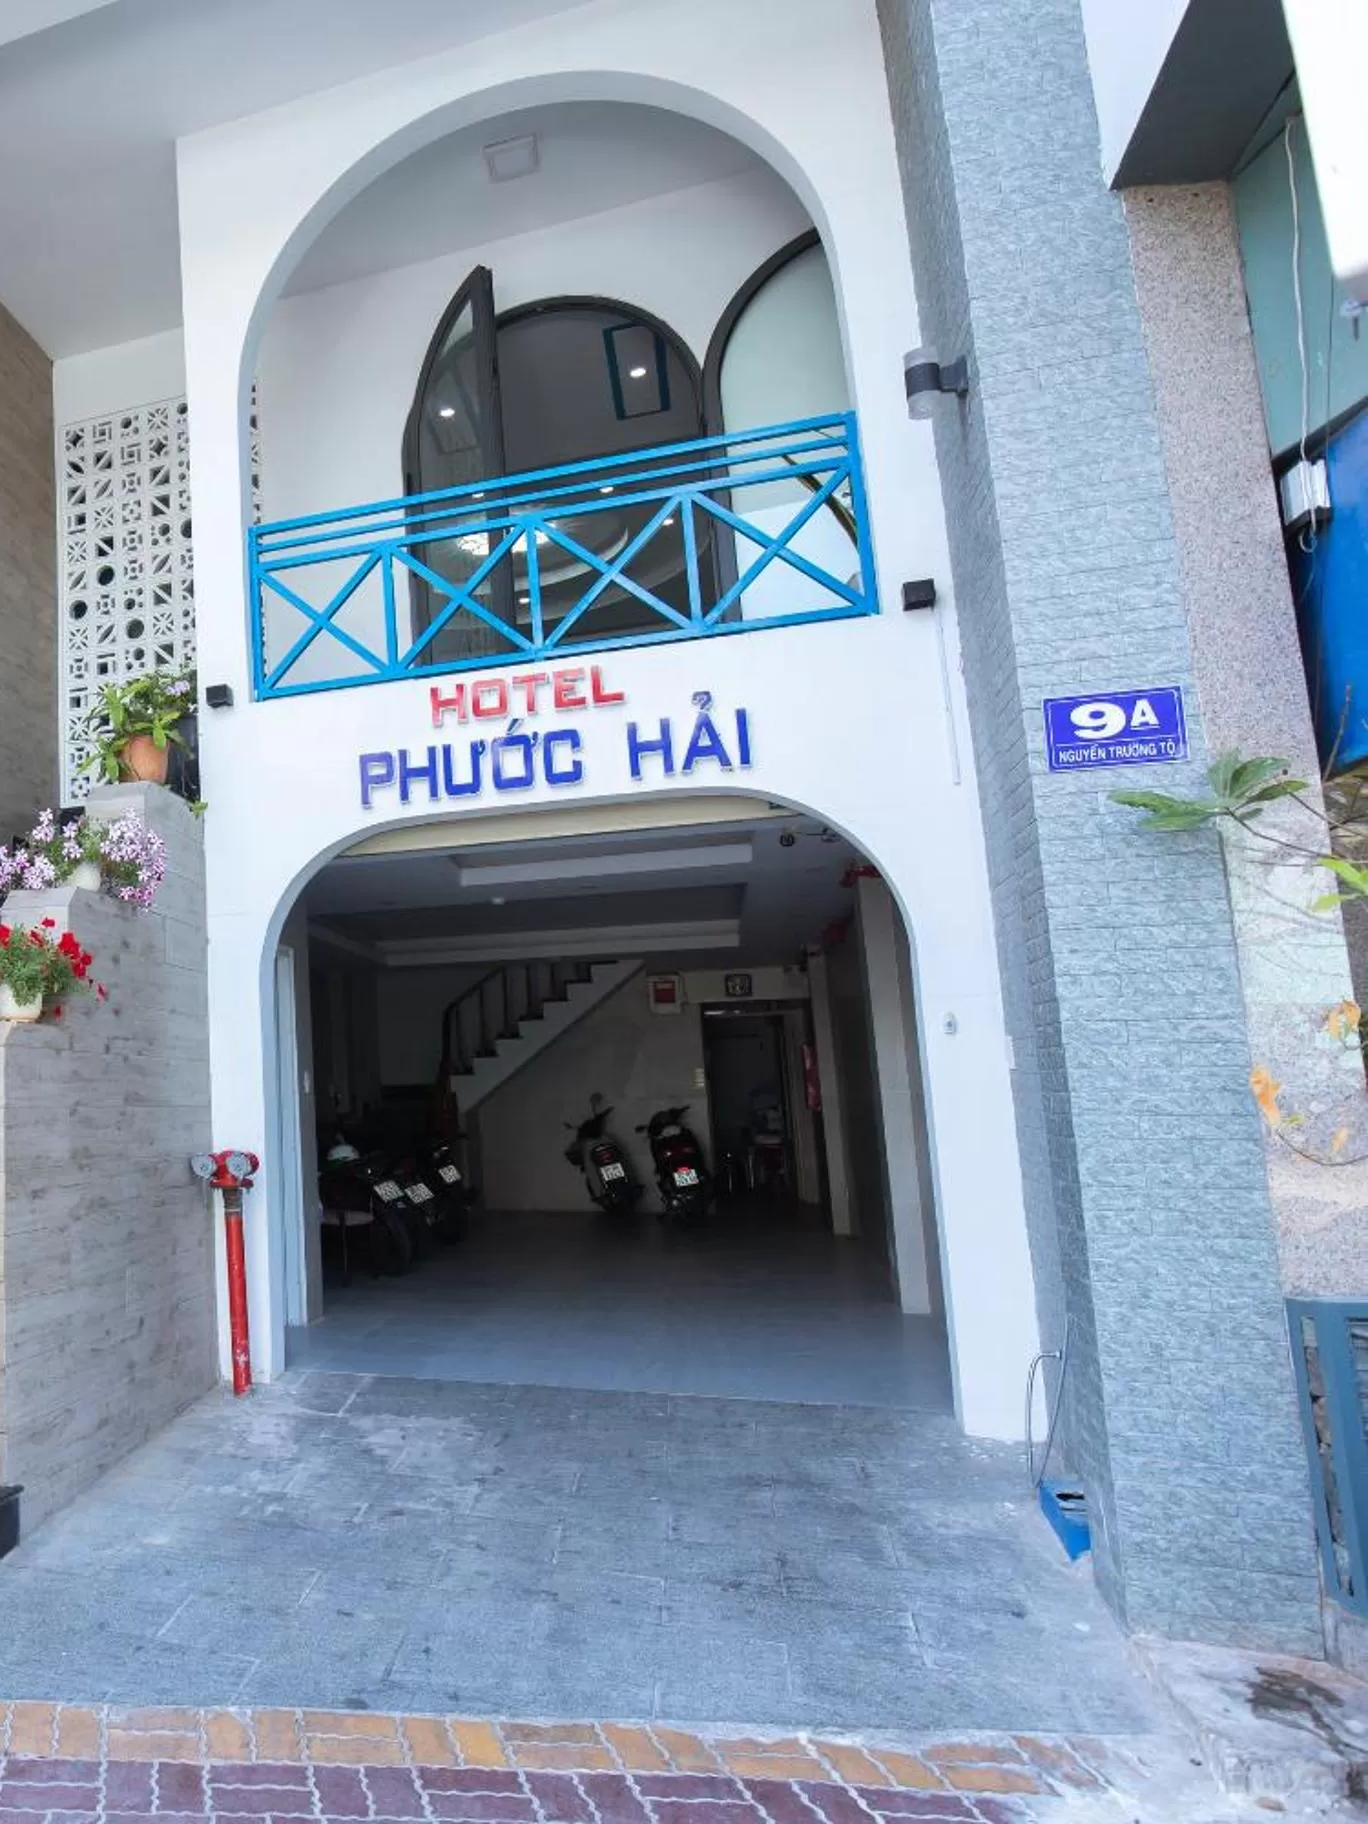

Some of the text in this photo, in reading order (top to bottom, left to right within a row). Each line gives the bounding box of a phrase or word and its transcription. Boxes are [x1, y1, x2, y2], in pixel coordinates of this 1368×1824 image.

[430, 665, 625, 727] HOTEL
[1070, 699, 1160, 739] 9A
[359, 690, 753, 808] PHƯỚC HẢI
